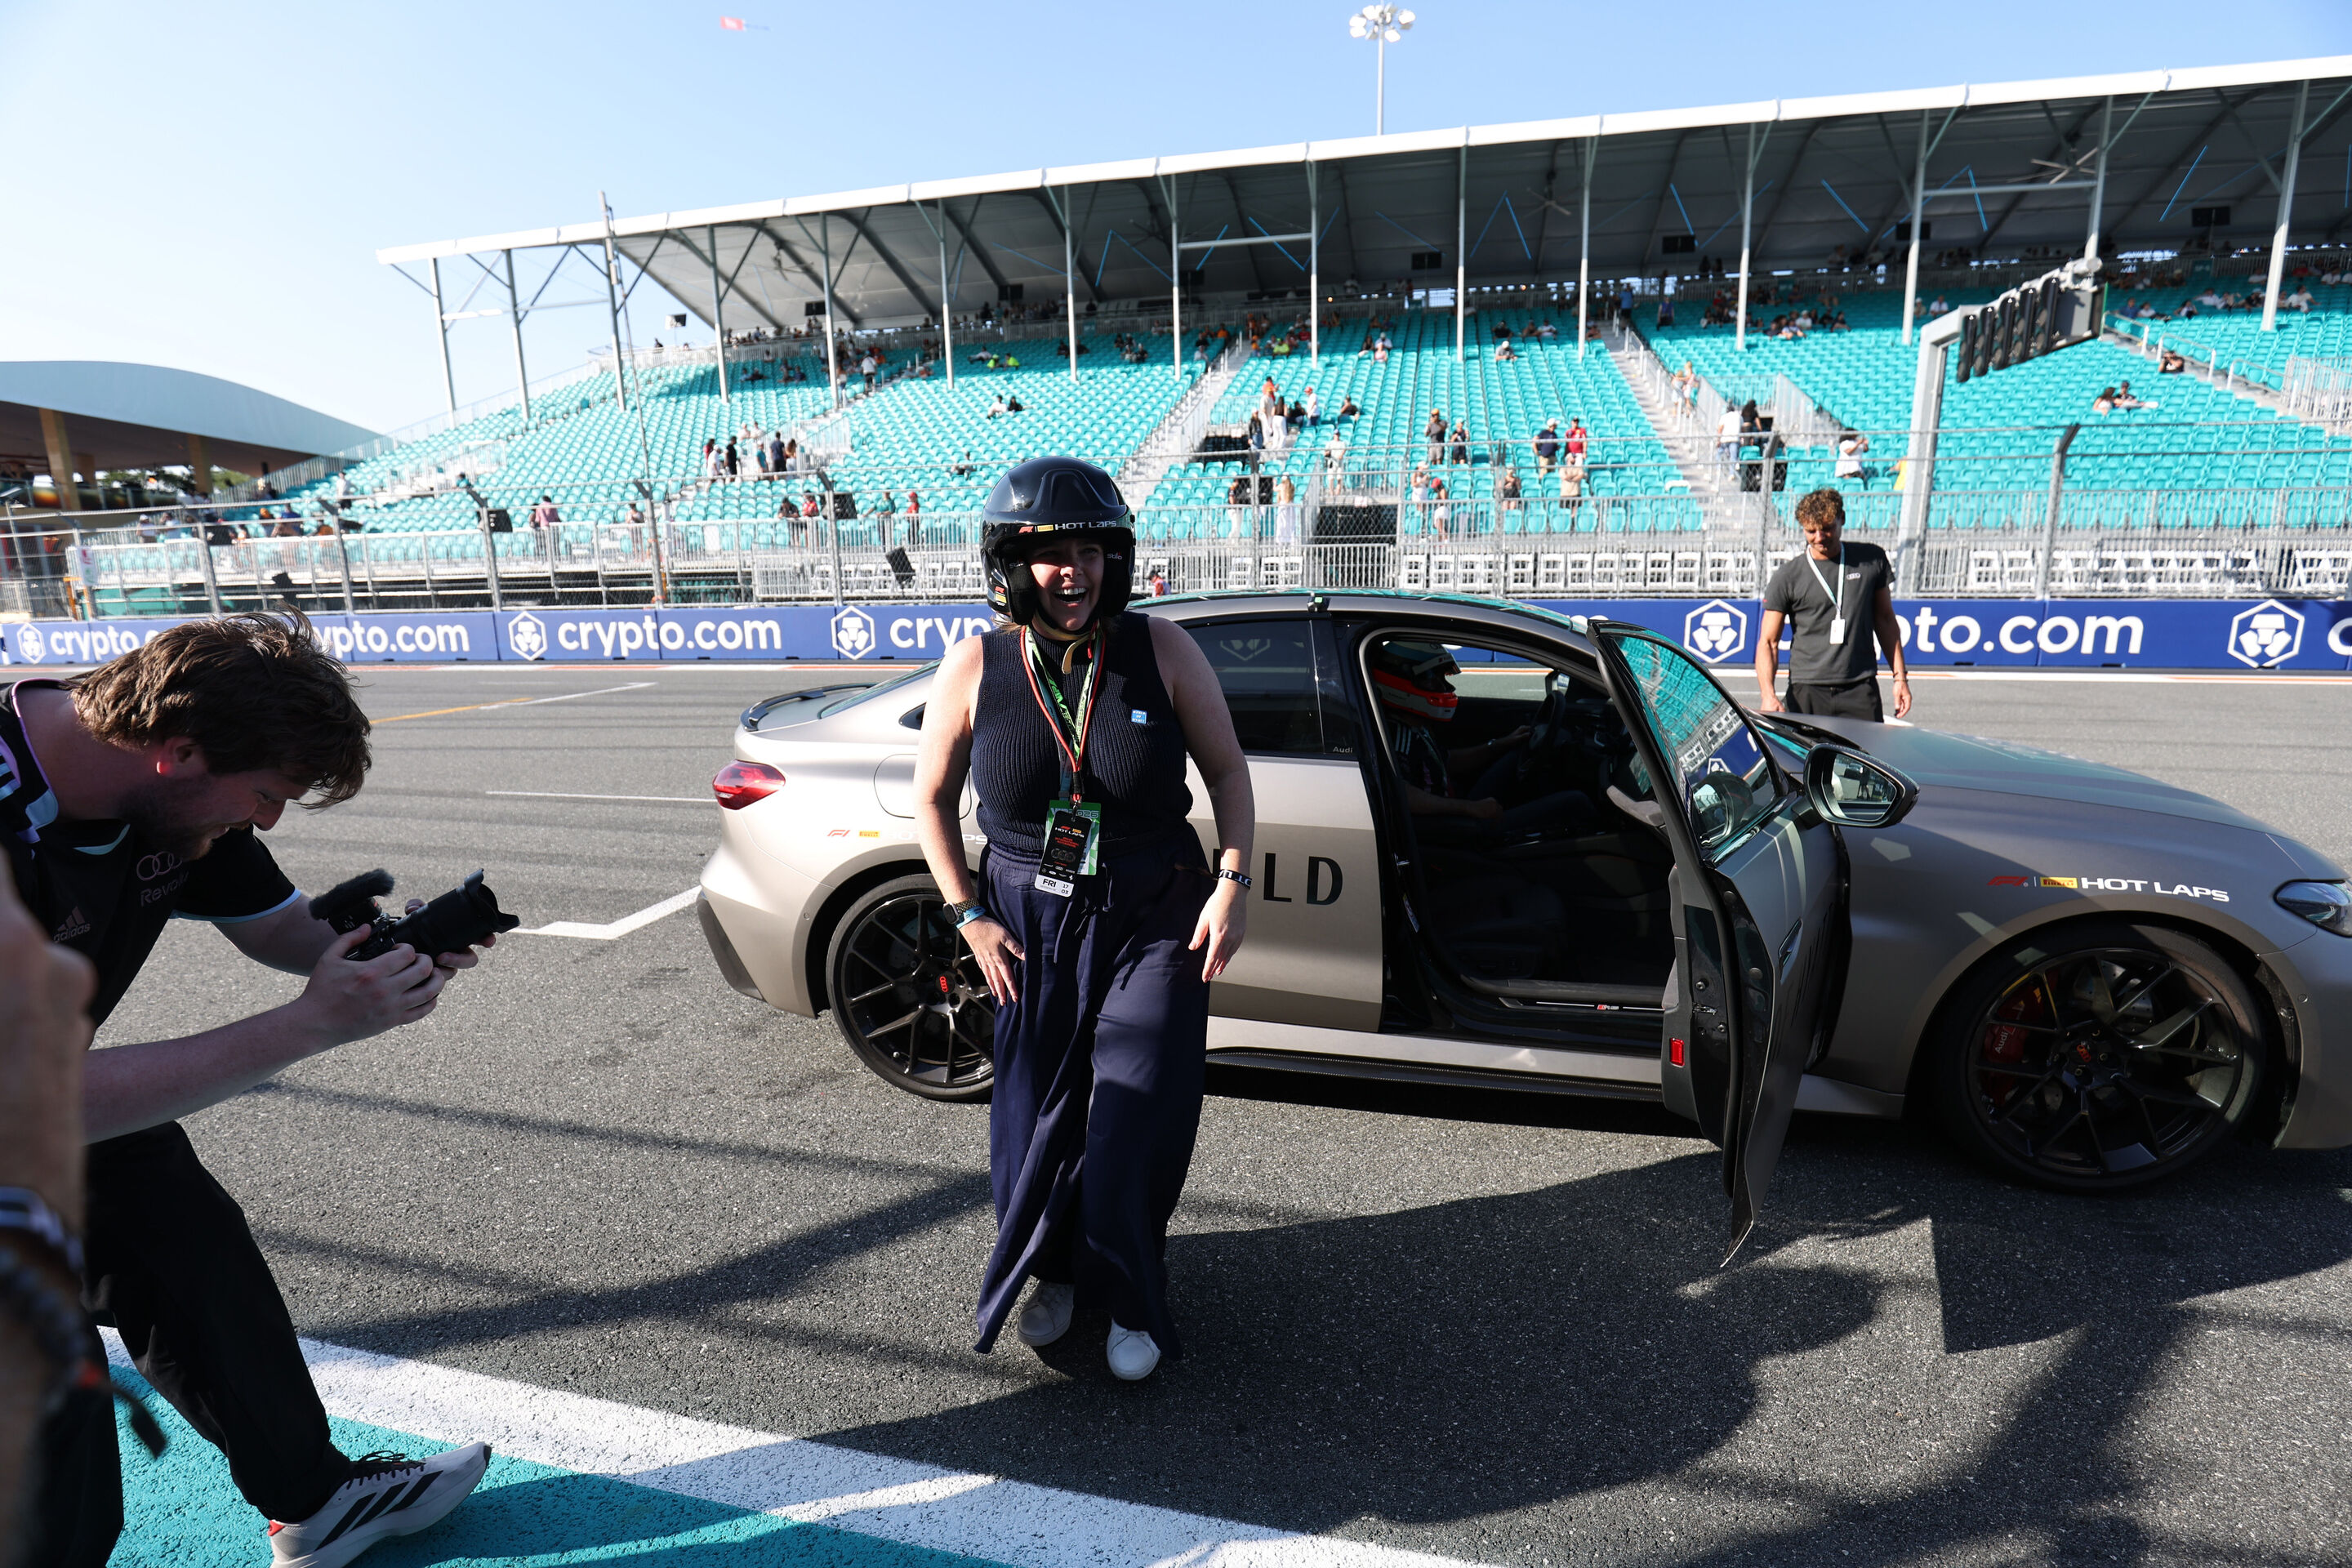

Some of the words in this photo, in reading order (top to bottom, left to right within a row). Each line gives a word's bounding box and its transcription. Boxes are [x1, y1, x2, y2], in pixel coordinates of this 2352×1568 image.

[1054, 522, 1086, 531] HOT
[1088, 520, 1117, 528] LAPS
[313, 620, 470, 659] ypto.com
[557, 614, 782, 657] crypto.com
[962, 834, 988, 844] PS
[1042, 878, 1057, 888] FRI
[2081, 877, 2149, 892] HOT
[2154, 881, 2230, 903] LAPS
[53, 922, 91, 943] adidas
[1994, 1031, 2009, 1054] Audi
